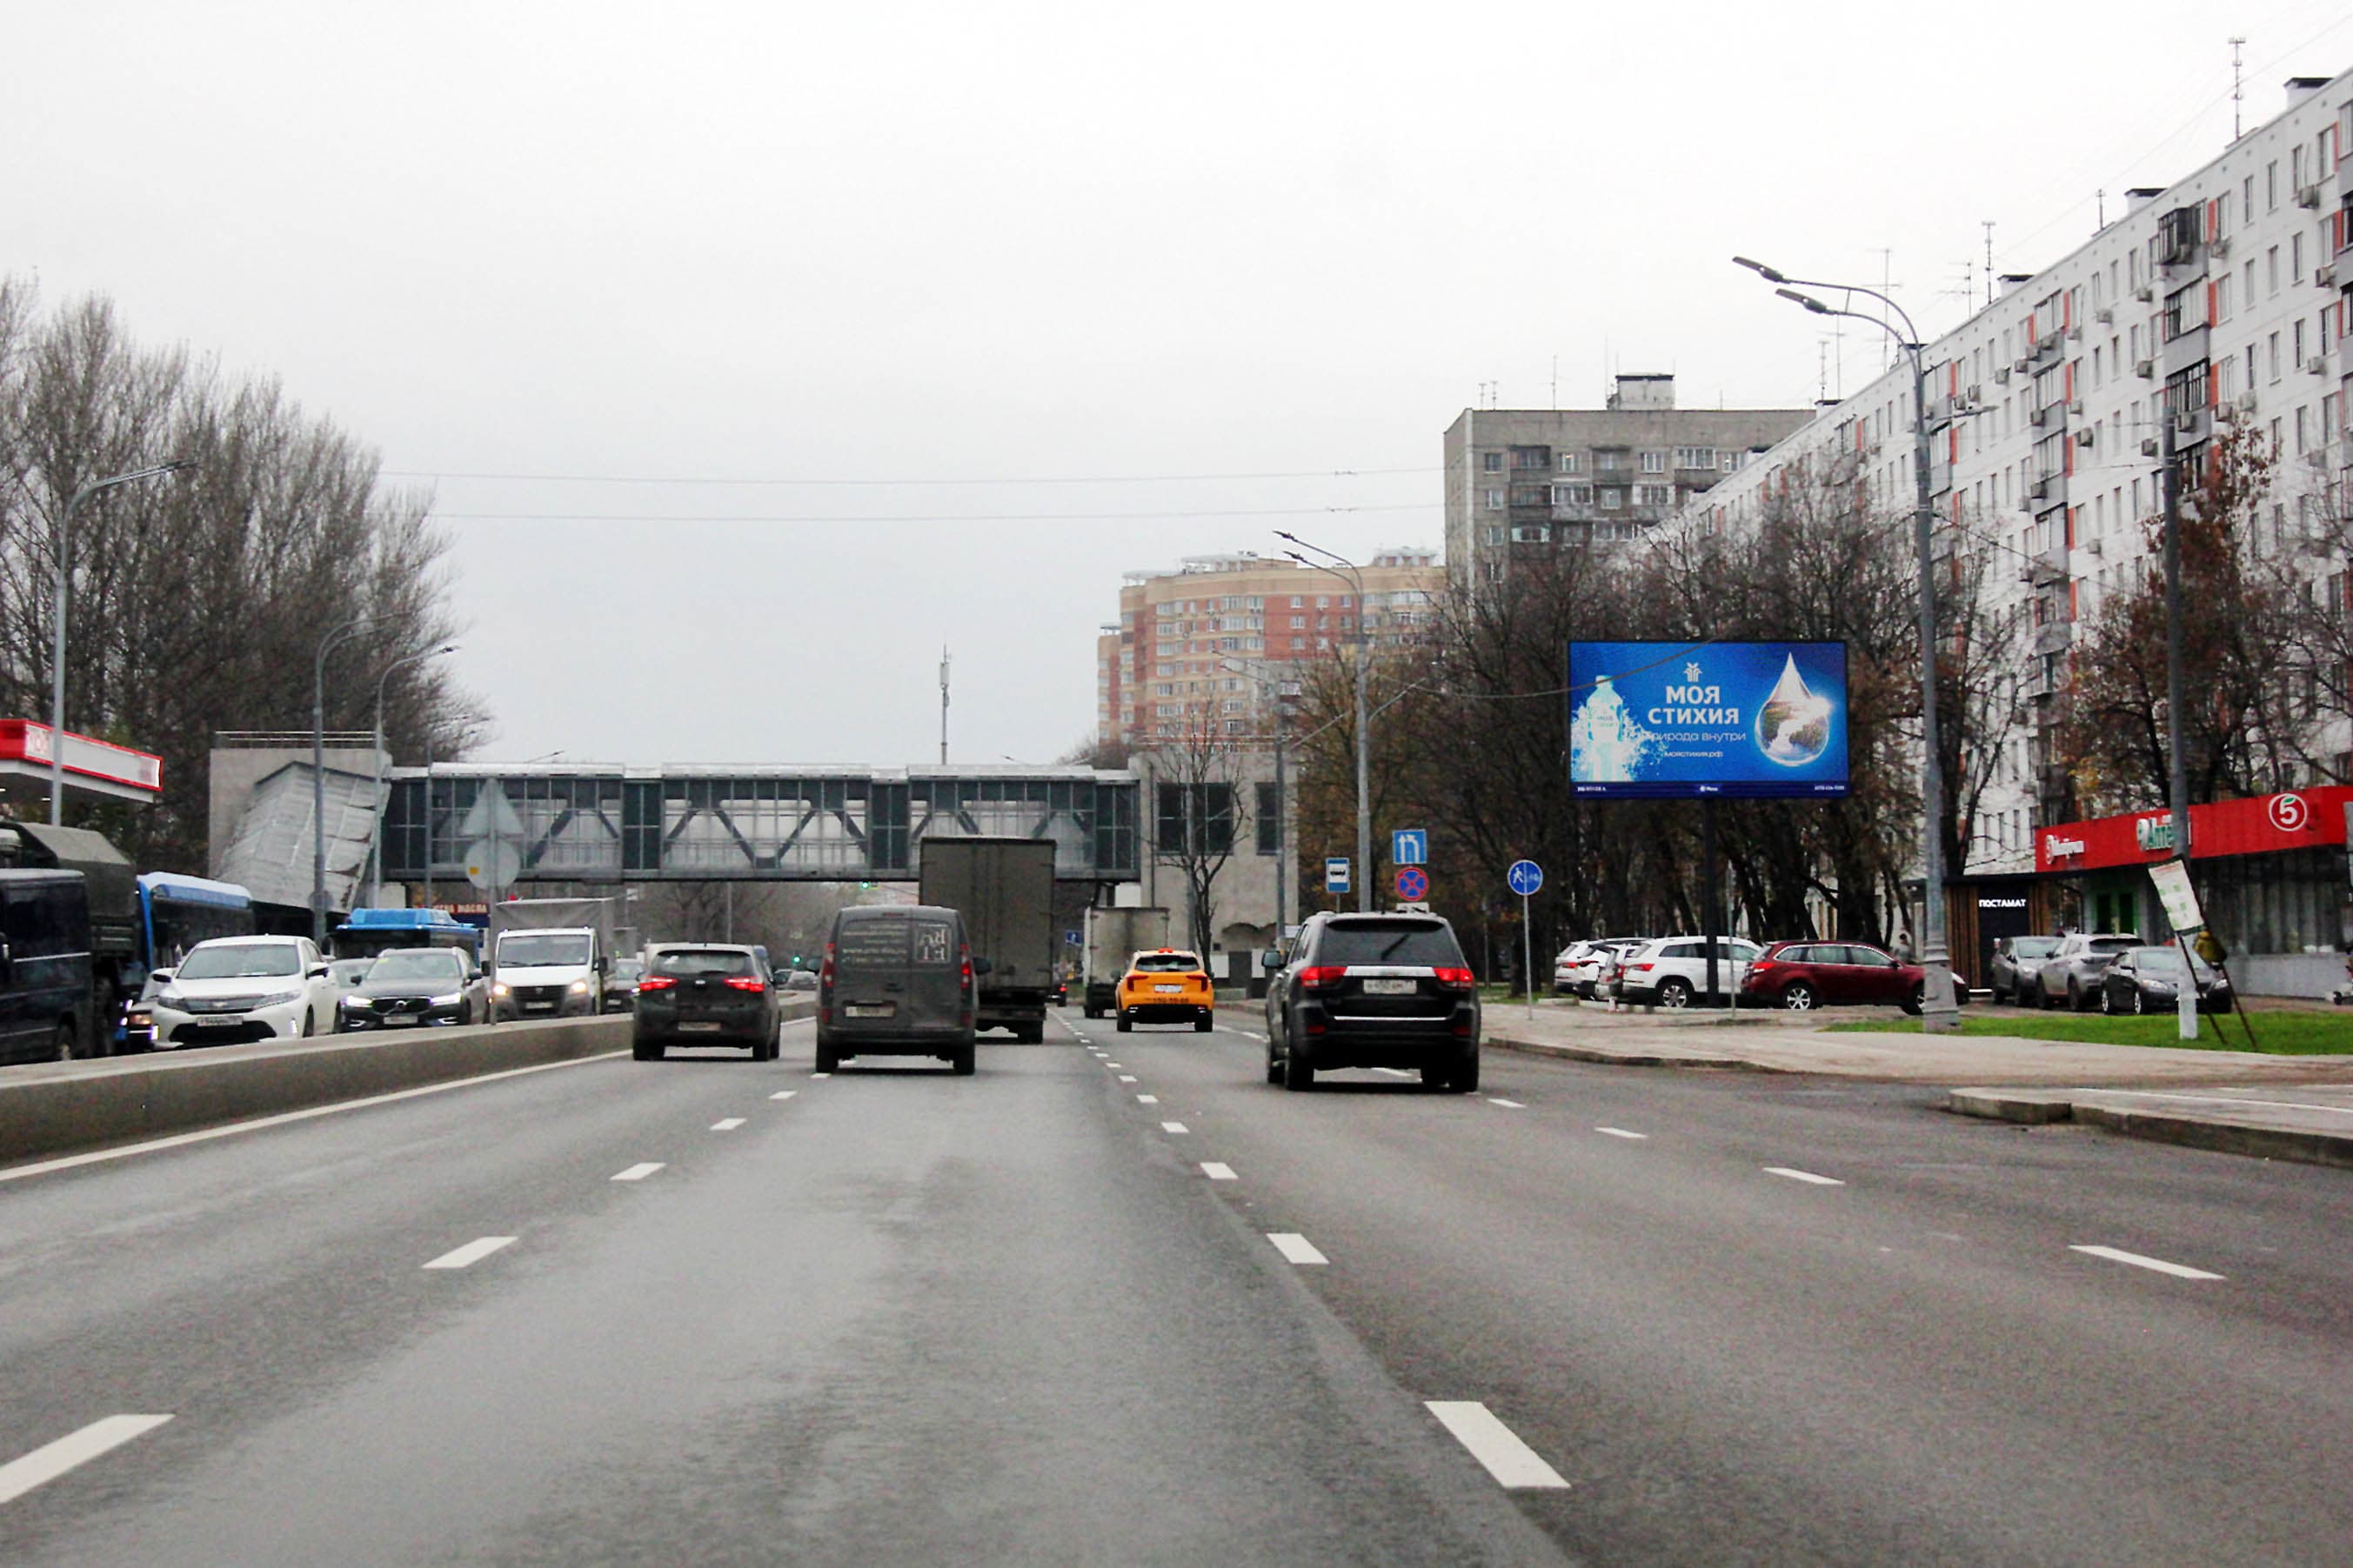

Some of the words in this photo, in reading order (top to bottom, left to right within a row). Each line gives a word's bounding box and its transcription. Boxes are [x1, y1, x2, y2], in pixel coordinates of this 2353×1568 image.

[1666, 685, 1721, 704] МОЯ
[1648, 708, 1740, 724] СТИХИЯ
[1645, 732, 1699, 743] рирода
[1701, 732, 1747, 743] внутри
[2280, 795, 2298, 824] 5
[1978, 898, 2027, 908] ПОСТАМАТ
